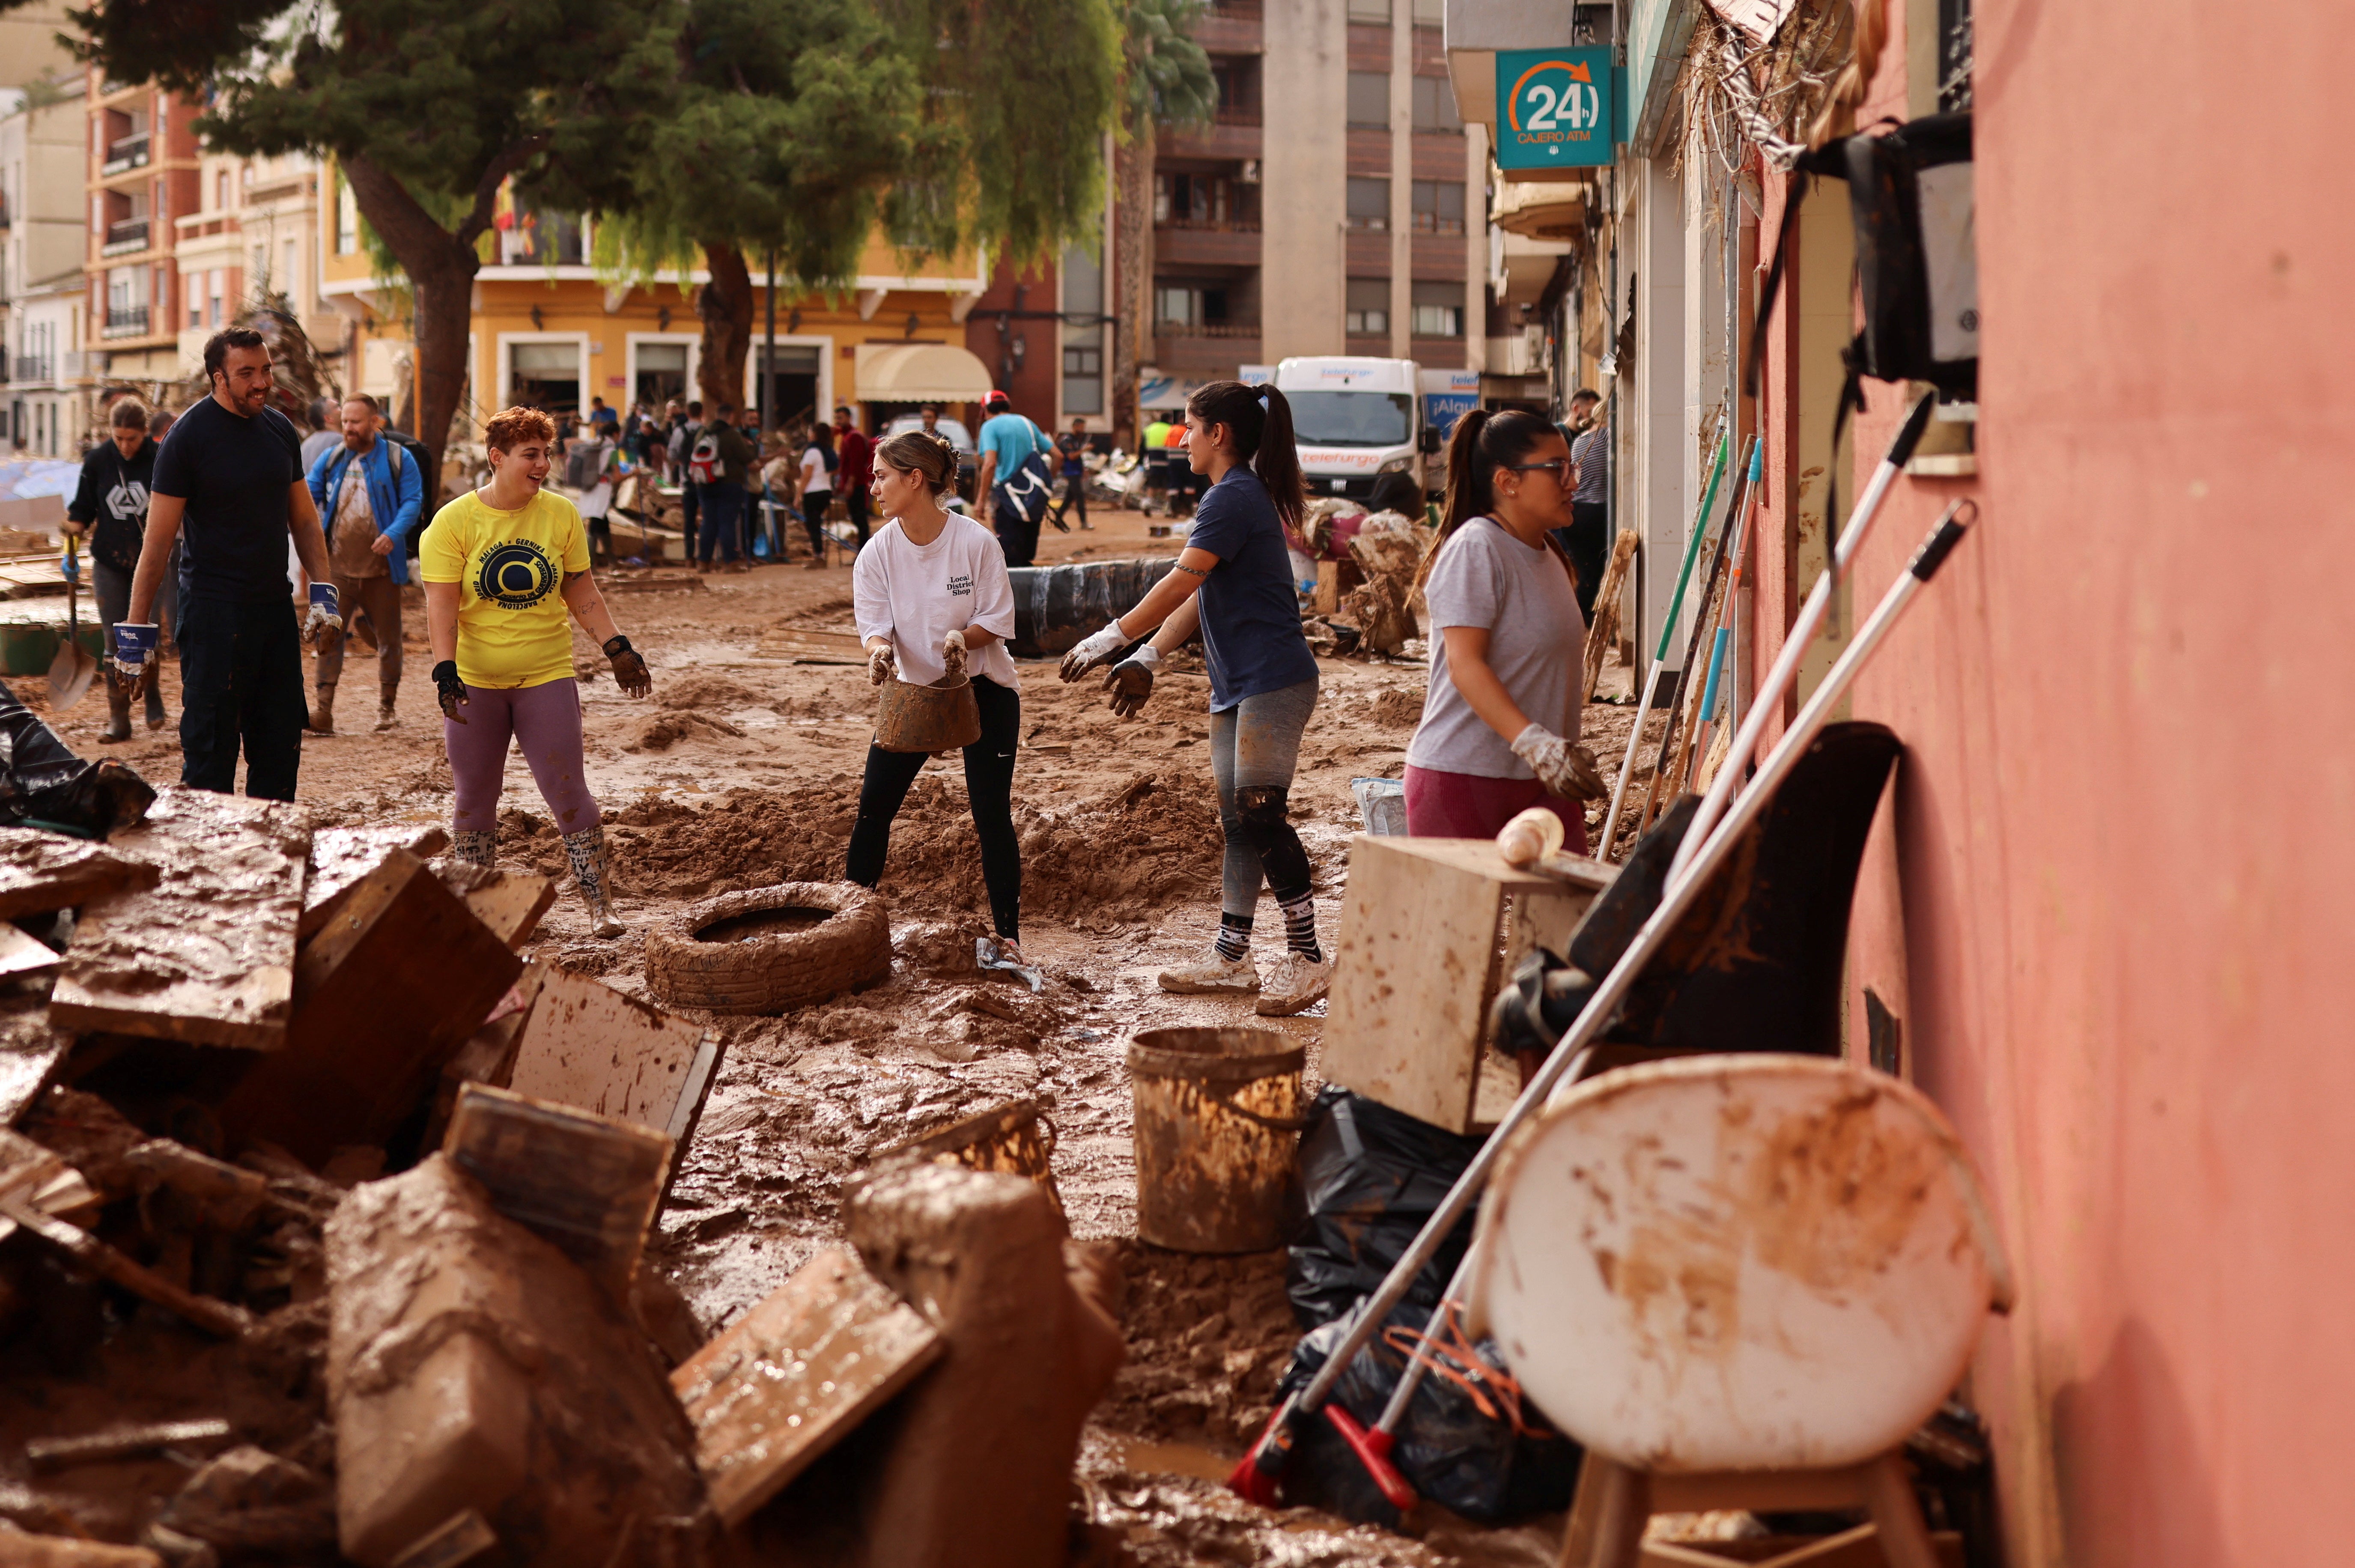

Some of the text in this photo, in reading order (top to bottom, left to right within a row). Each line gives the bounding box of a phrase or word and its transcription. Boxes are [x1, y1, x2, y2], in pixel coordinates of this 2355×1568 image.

[1517, 130, 1590, 144] CAJERO ATM
[1303, 453, 1381, 468] telefurgo
[479, 541, 503, 564] MÁLAGA
[516, 538, 545, 553] GERNIKA
[548, 563, 558, 594] VALENCIA
[947, 580, 974, 590] District
[950, 574, 970, 583] Local
[527, 591, 536, 599] DE
[497, 600, 538, 610] BARCELONA
